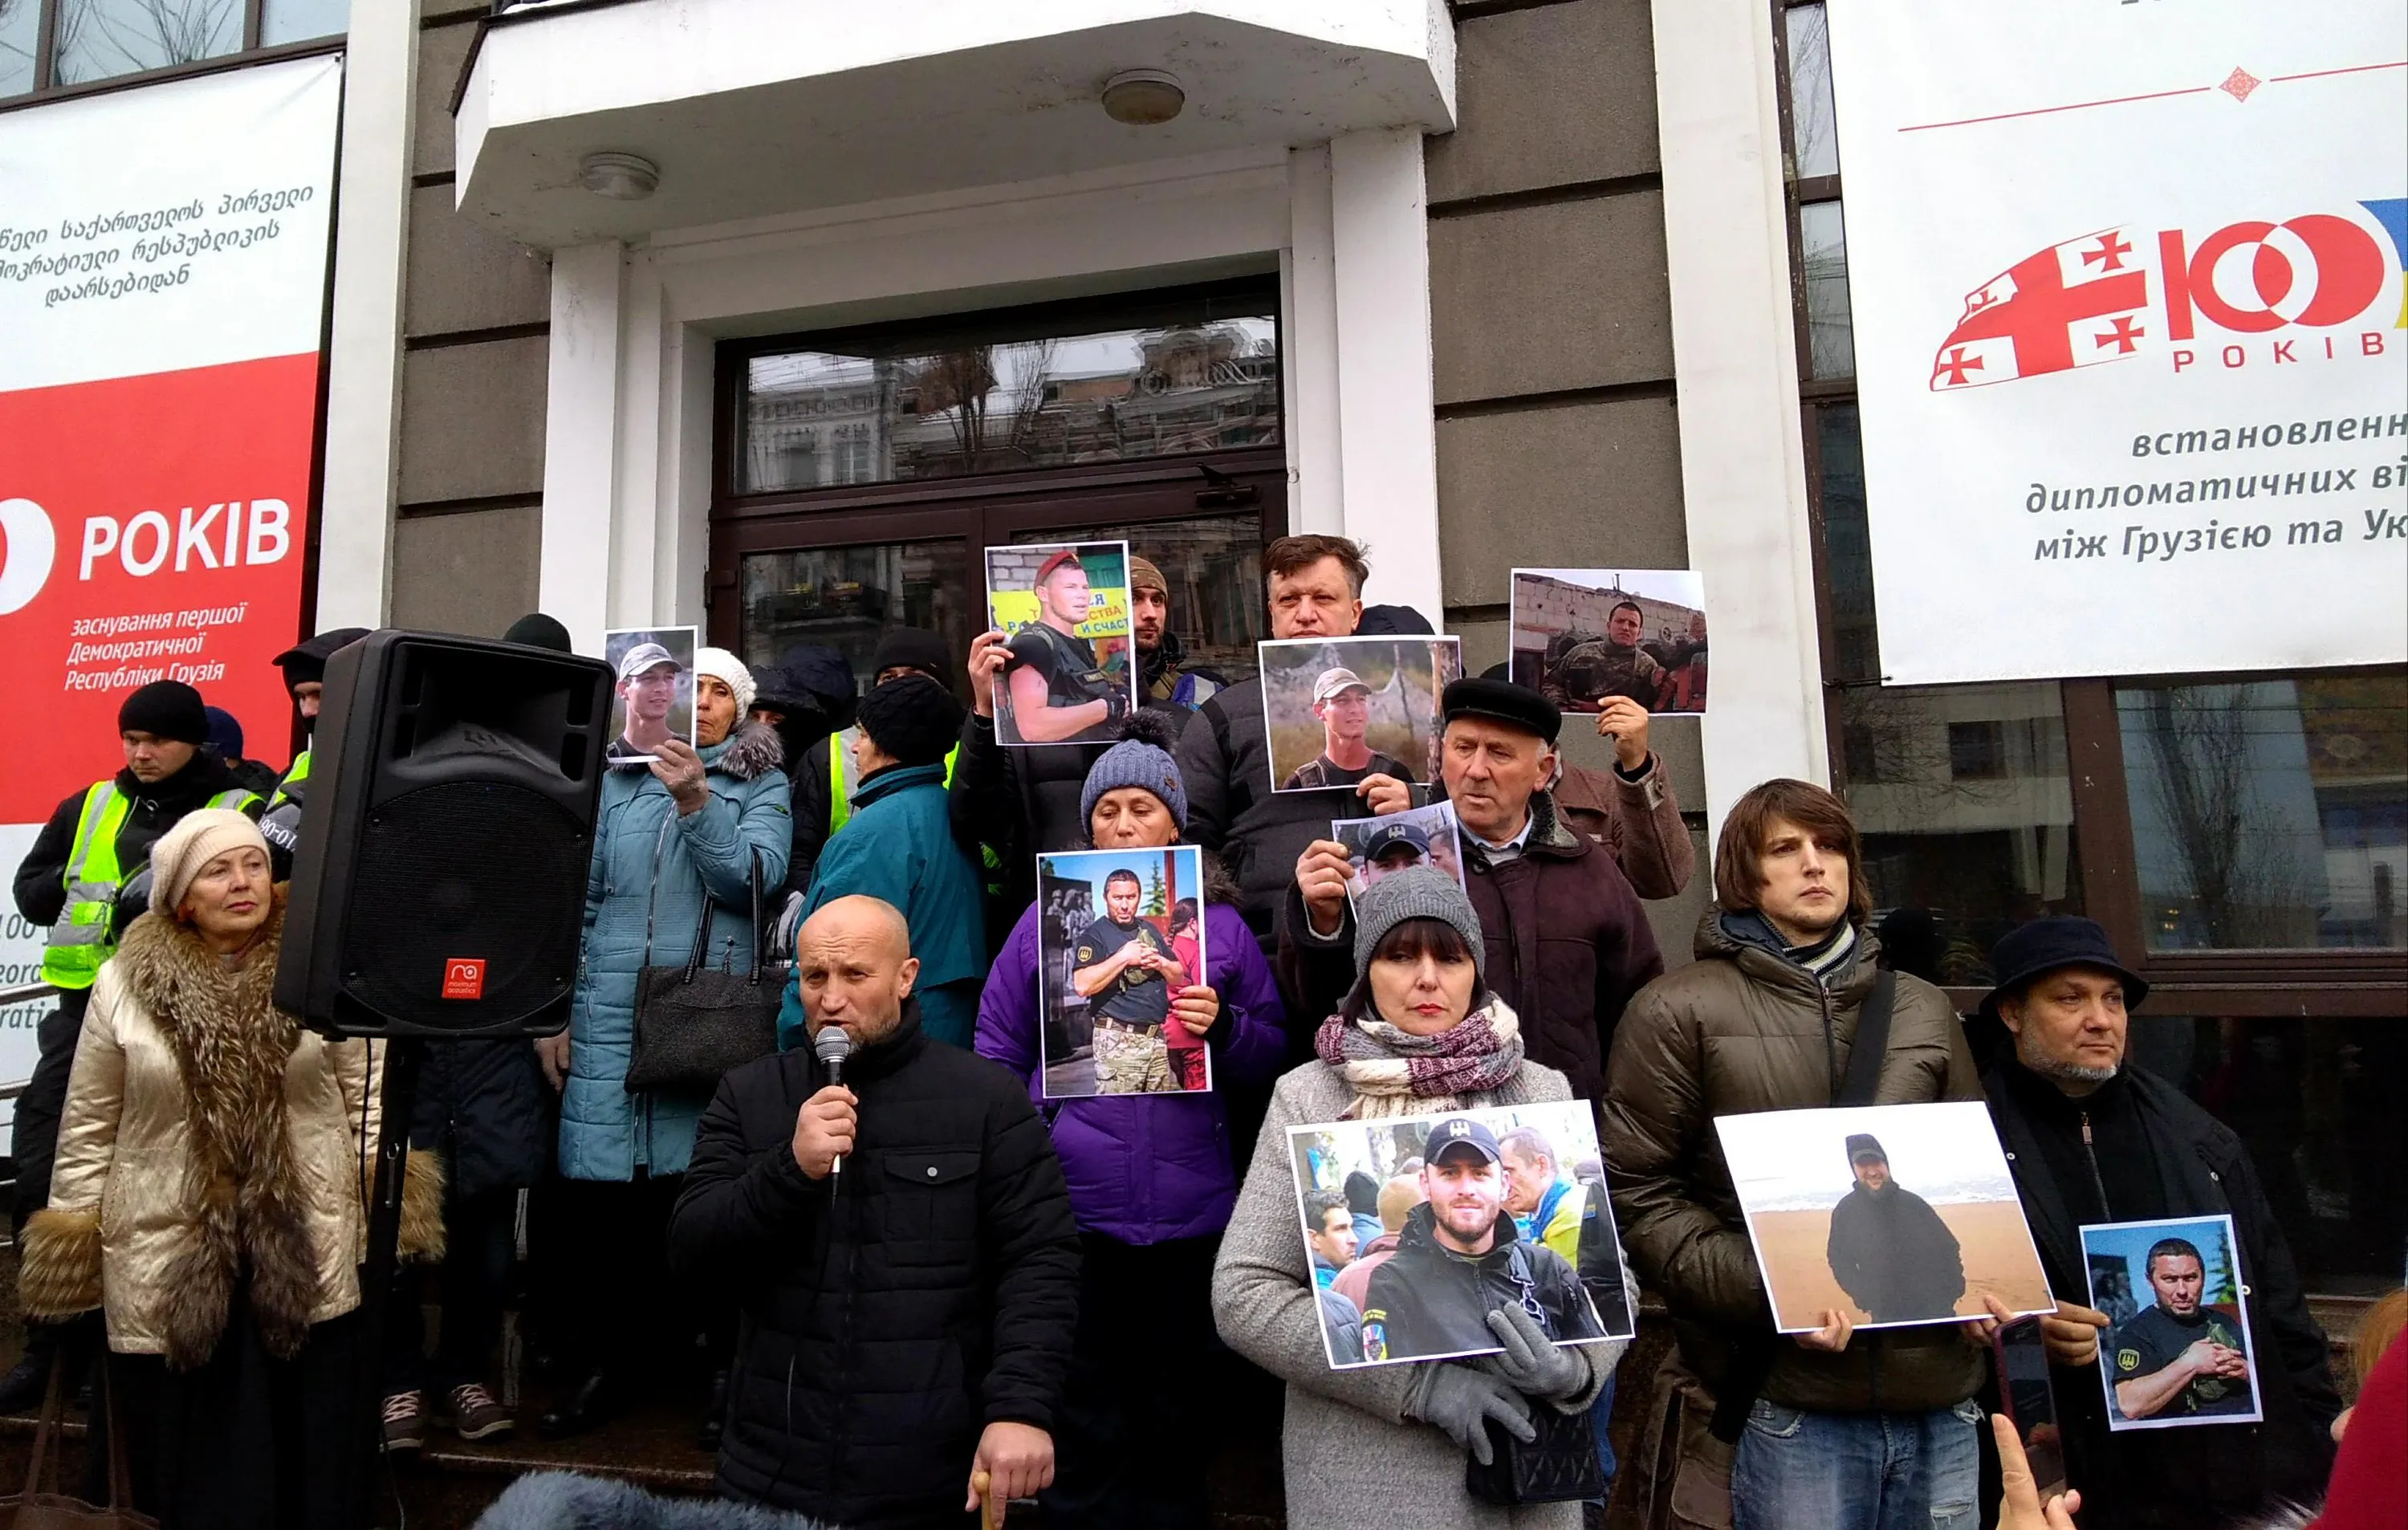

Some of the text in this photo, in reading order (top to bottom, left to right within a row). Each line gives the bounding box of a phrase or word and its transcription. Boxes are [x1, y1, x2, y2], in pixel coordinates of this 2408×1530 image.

[60, 198, 204, 241] საქართველოს
[218, 185, 314, 215] პირველი
[131, 218, 281, 263] რესპუბლიკის
[45, 263, 191, 307] დაარსებიდან
[2172, 332, 2385, 373] РОКІВ
[2130, 412, 2407, 458] встановленн
[2025, 467, 2357, 514] дипломатичних
[79, 498, 291, 581] РОКІВ
[2034, 528, 2109, 561] між
[2121, 519, 2272, 564] Грузією
[2287, 519, 2344, 547] та
[71, 602, 249, 639] заснування першої
[66, 632, 207, 666] Демократичної
[64, 659, 226, 692] Республіки Грузія
